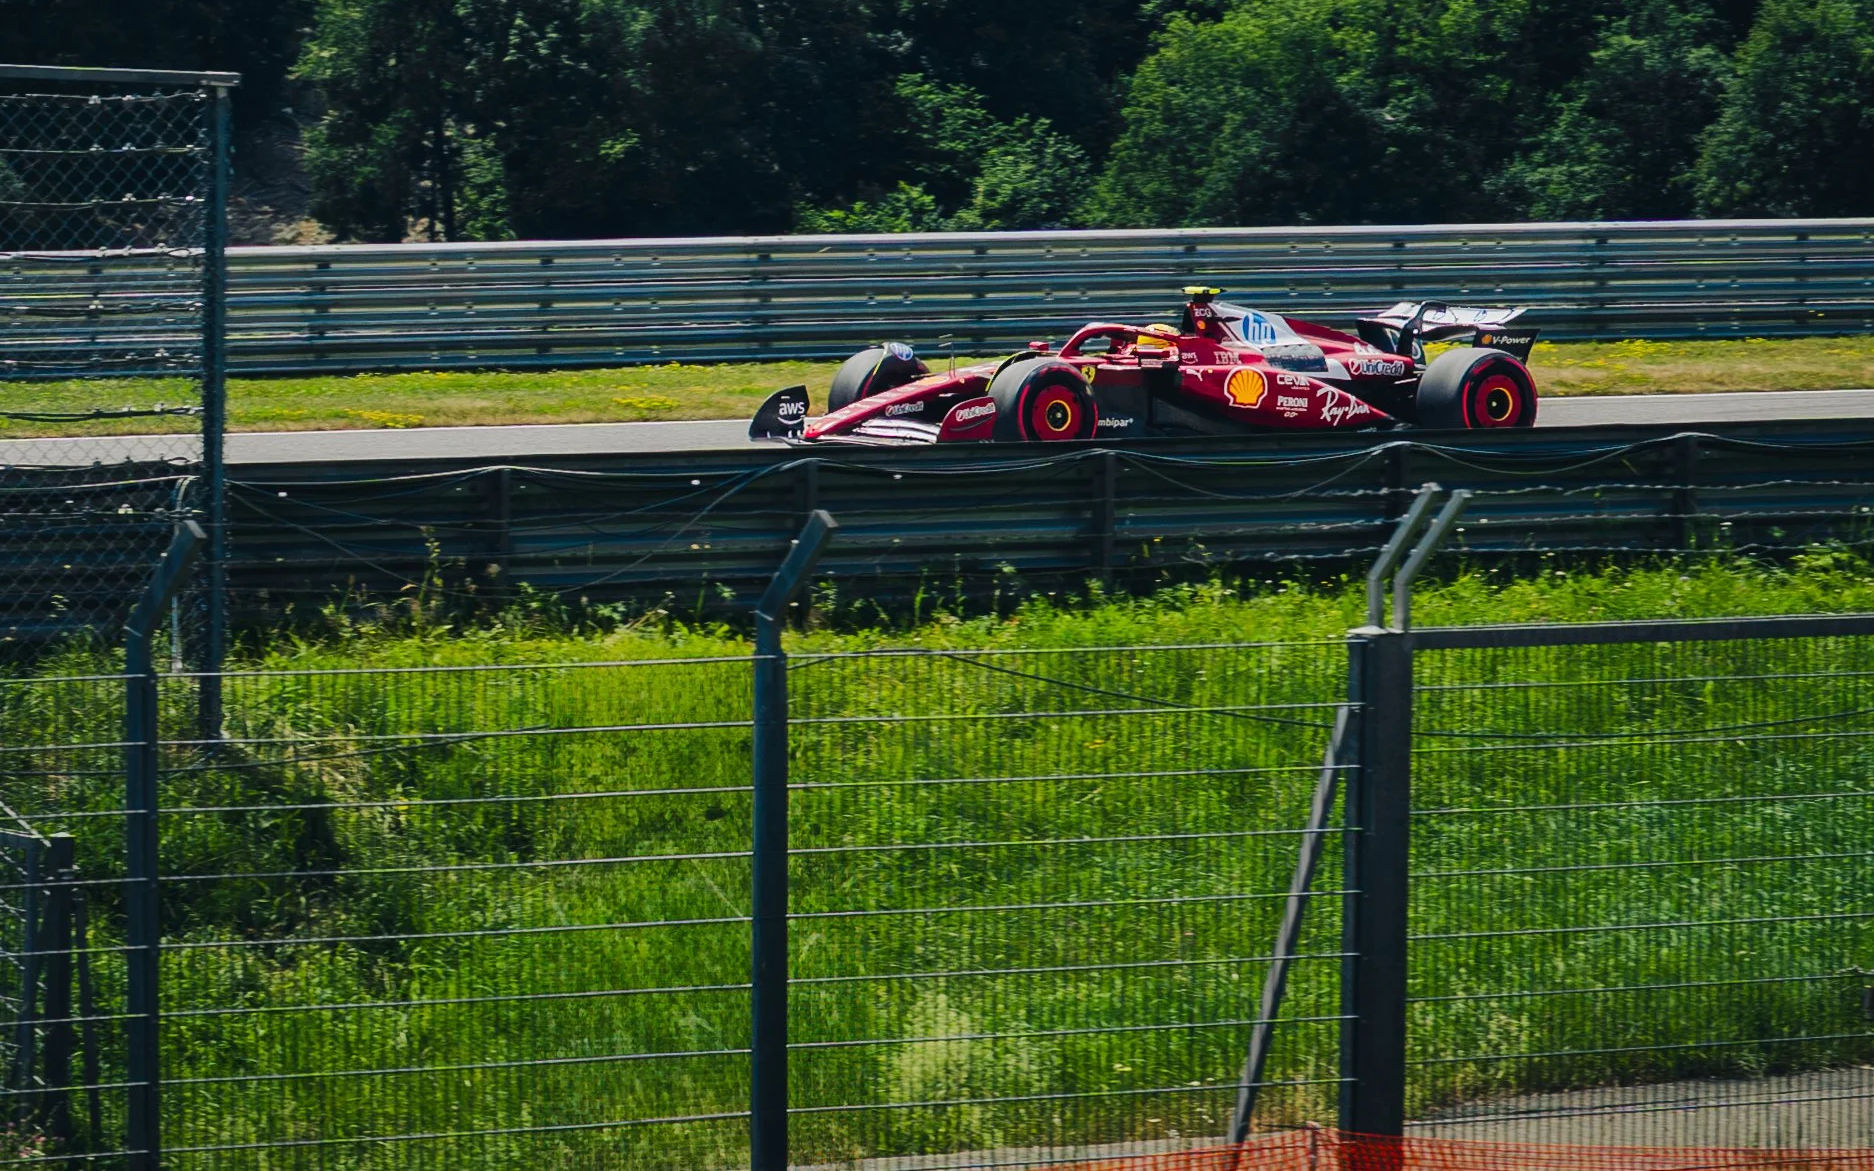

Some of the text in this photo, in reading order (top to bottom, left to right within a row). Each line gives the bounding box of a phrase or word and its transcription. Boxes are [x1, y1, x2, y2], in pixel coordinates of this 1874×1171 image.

[1247, 313, 1275, 344] hp
[1492, 336, 1531, 345] V-Power
[1213, 351, 1242, 365] IBM
[1361, 360, 1404, 376] UniCredit
[778, 401, 805, 416] aws
[1277, 395, 1308, 408] PERONI
[1097, 417, 1130, 428] mbipar
